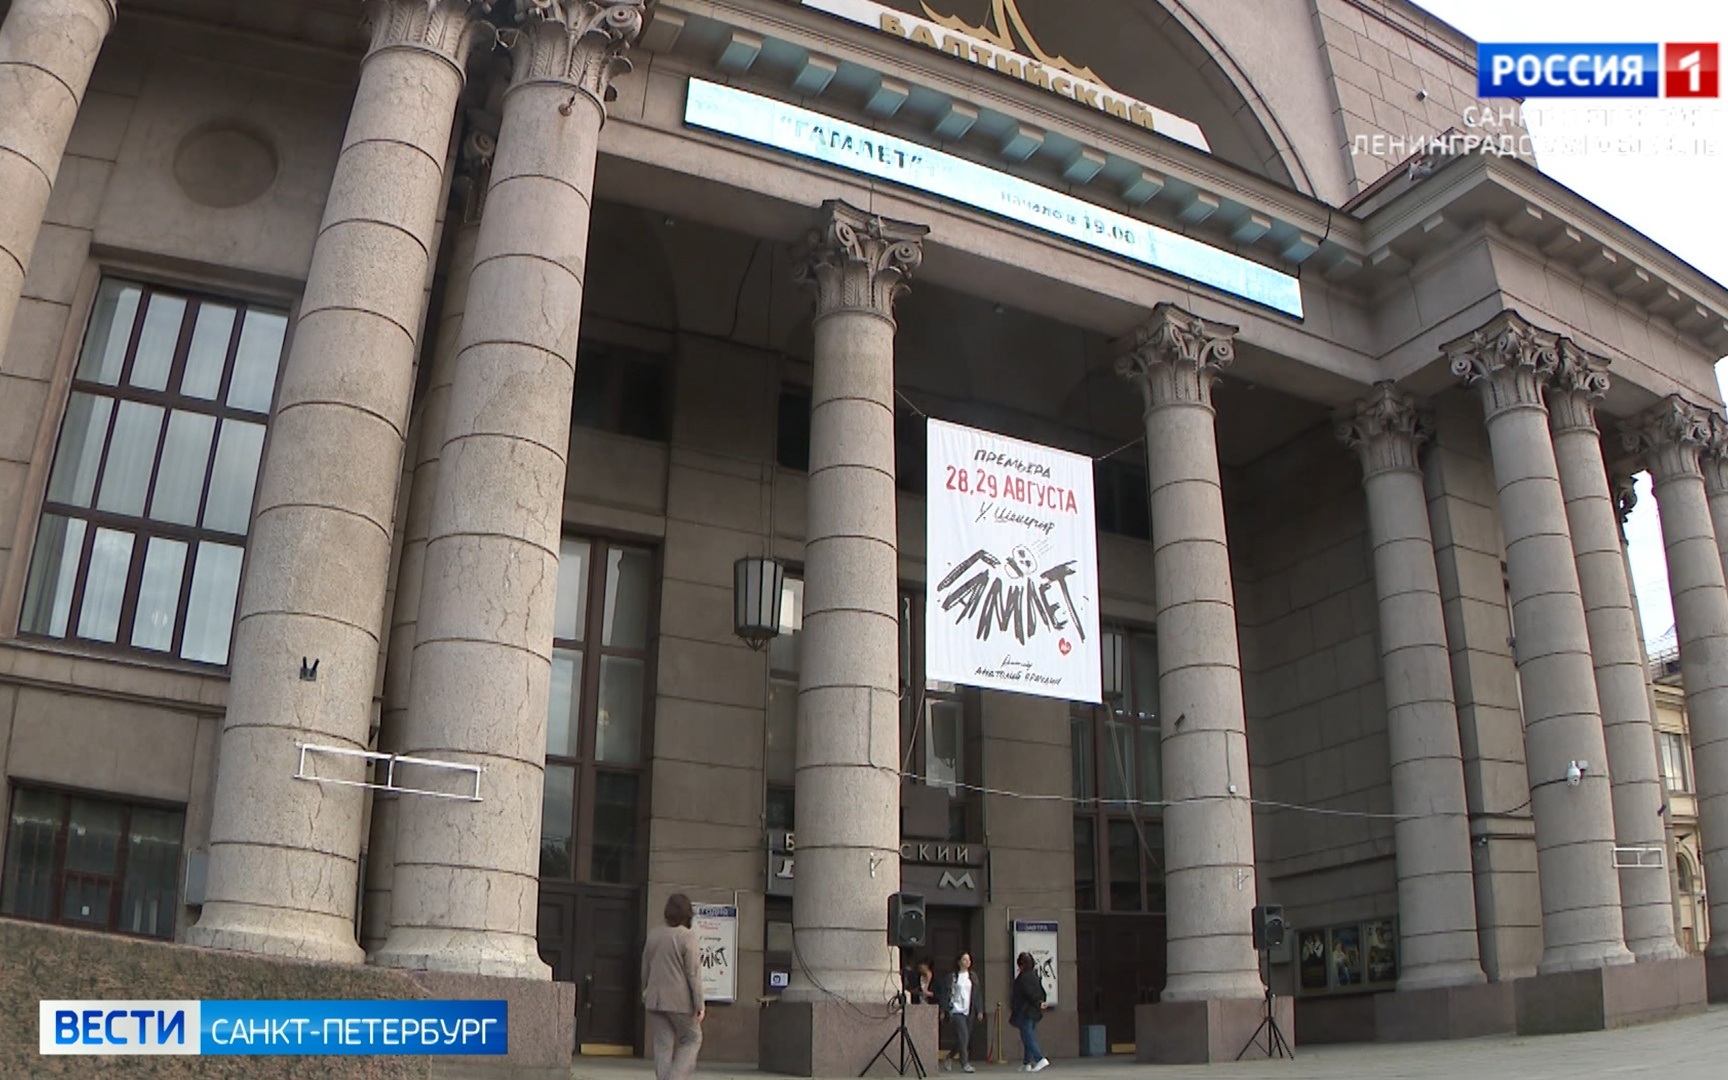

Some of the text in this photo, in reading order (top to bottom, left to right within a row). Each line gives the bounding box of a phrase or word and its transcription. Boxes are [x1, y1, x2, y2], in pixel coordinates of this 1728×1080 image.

[880, 12, 1154, 130] БАЛТИЙСКИЙ
[974, 449, 1051, 479] ПРЕМЬЕРА
[1003, 474, 1078, 515] АВГУСТА
[937, 549, 1085, 645] ГАМЛЕТ
